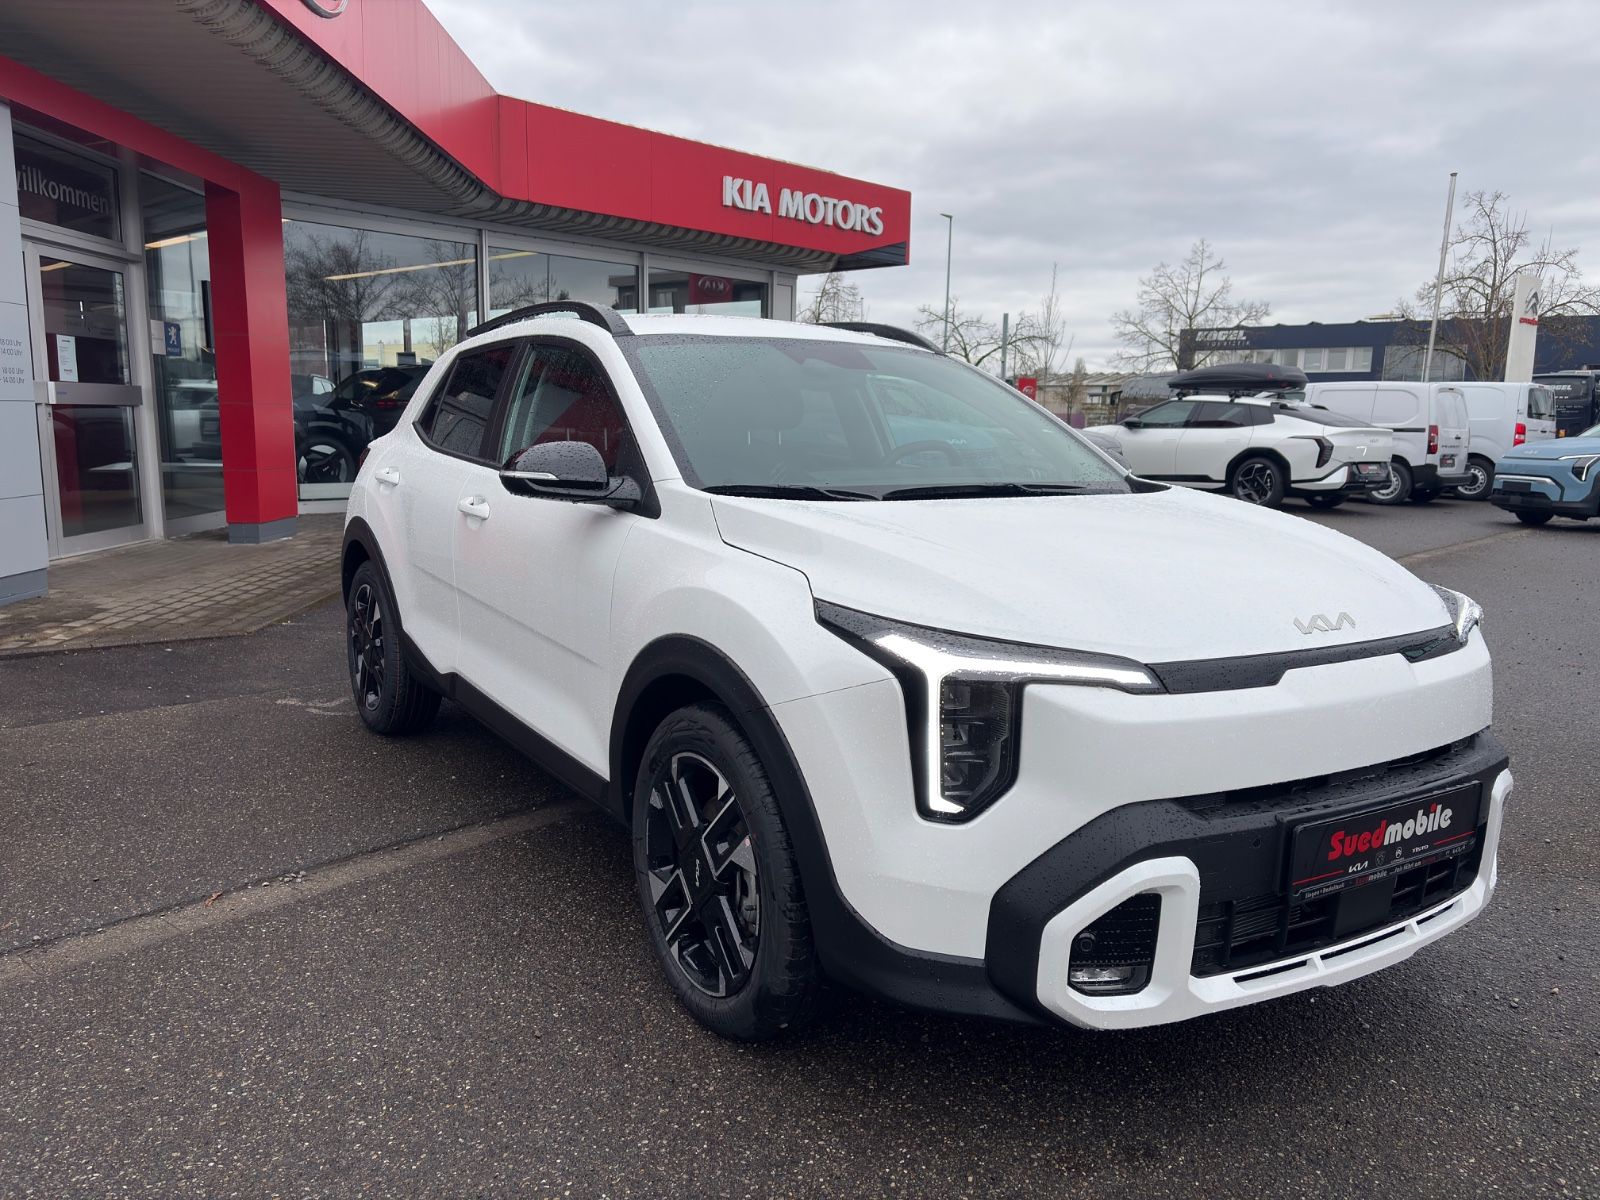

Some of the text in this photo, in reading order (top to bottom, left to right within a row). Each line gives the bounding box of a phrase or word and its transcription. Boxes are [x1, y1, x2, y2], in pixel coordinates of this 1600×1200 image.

[722, 175, 884, 236] KIA MOTORS
[1327, 802, 1453, 861] Suedmobile
